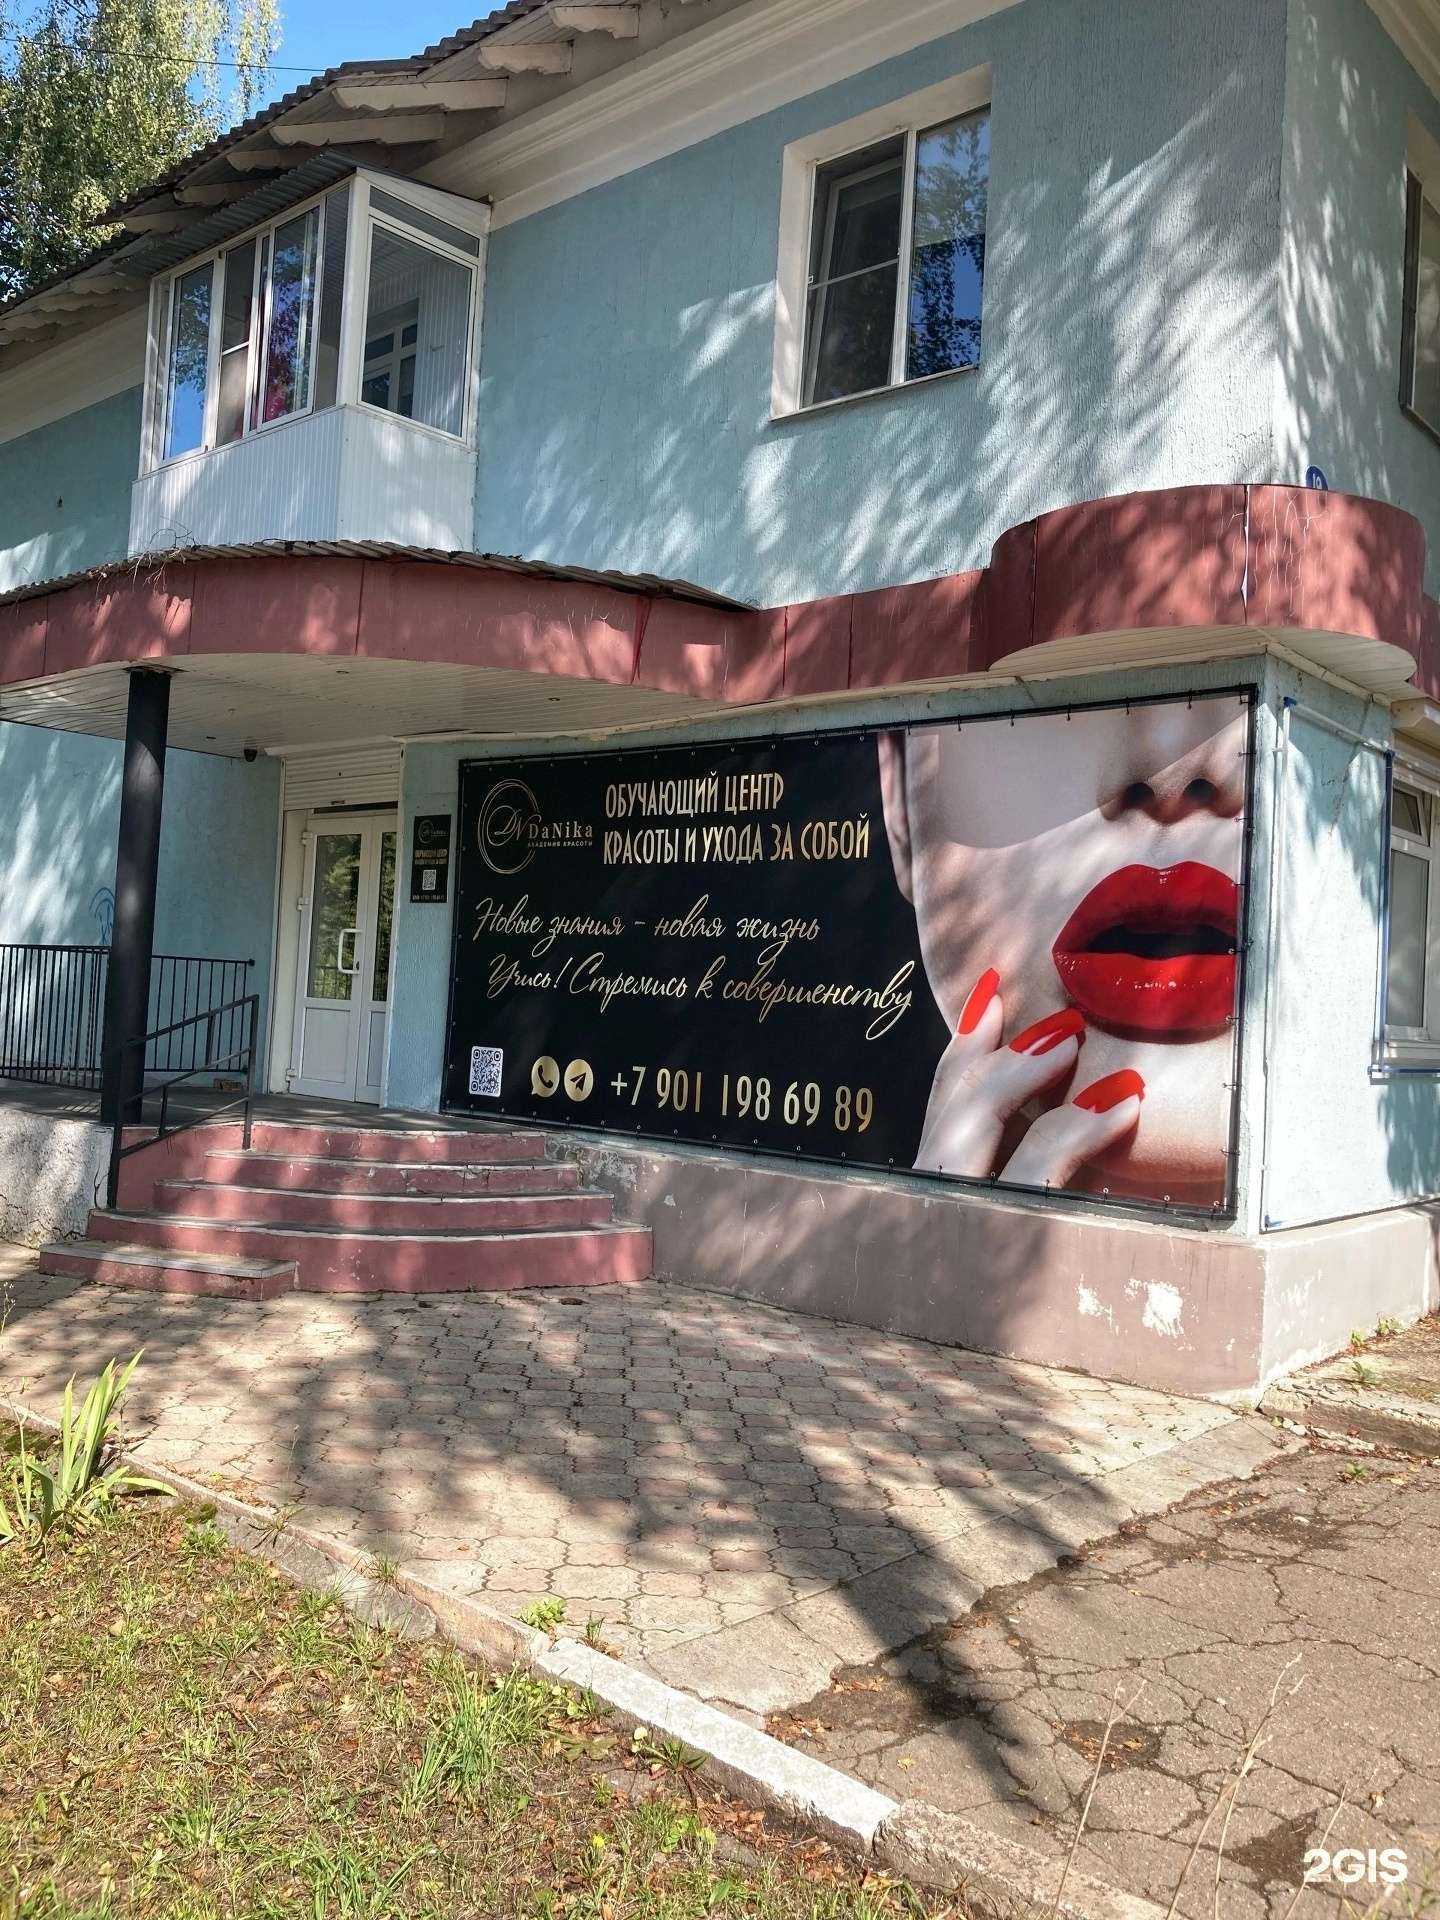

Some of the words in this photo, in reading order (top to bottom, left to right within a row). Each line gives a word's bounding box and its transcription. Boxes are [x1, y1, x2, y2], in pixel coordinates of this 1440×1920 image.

[605, 771, 718, 818] ОБУЧАЮЩИЙ
[725, 772, 784, 815] ЦЕНТР
[529, 821, 593, 839] DaNika
[603, 828, 678, 865] КРАСОТЫ
[685, 827, 697, 863] И
[702, 823, 763, 865] УХОДА
[771, 822, 793, 860] ЗА
[801, 812, 869, 860] СОБОЙ
[473, 894, 543, 942] Новые
[532, 915, 626, 958] знания
[654, 894, 727, 938] новая
[736, 915, 821, 966] жизнь
[487, 953, 574, 999] Учись!
[569, 952, 688, 1013] Стремись
[722, 956, 915, 1041] совершенству
[611, 1065, 647, 1106] +7
[656, 1067, 702, 1113] 901
[723, 1074, 771, 1121] 198
[783, 1081, 821, 1126] 69
[835, 1085, 874, 1133] 89
